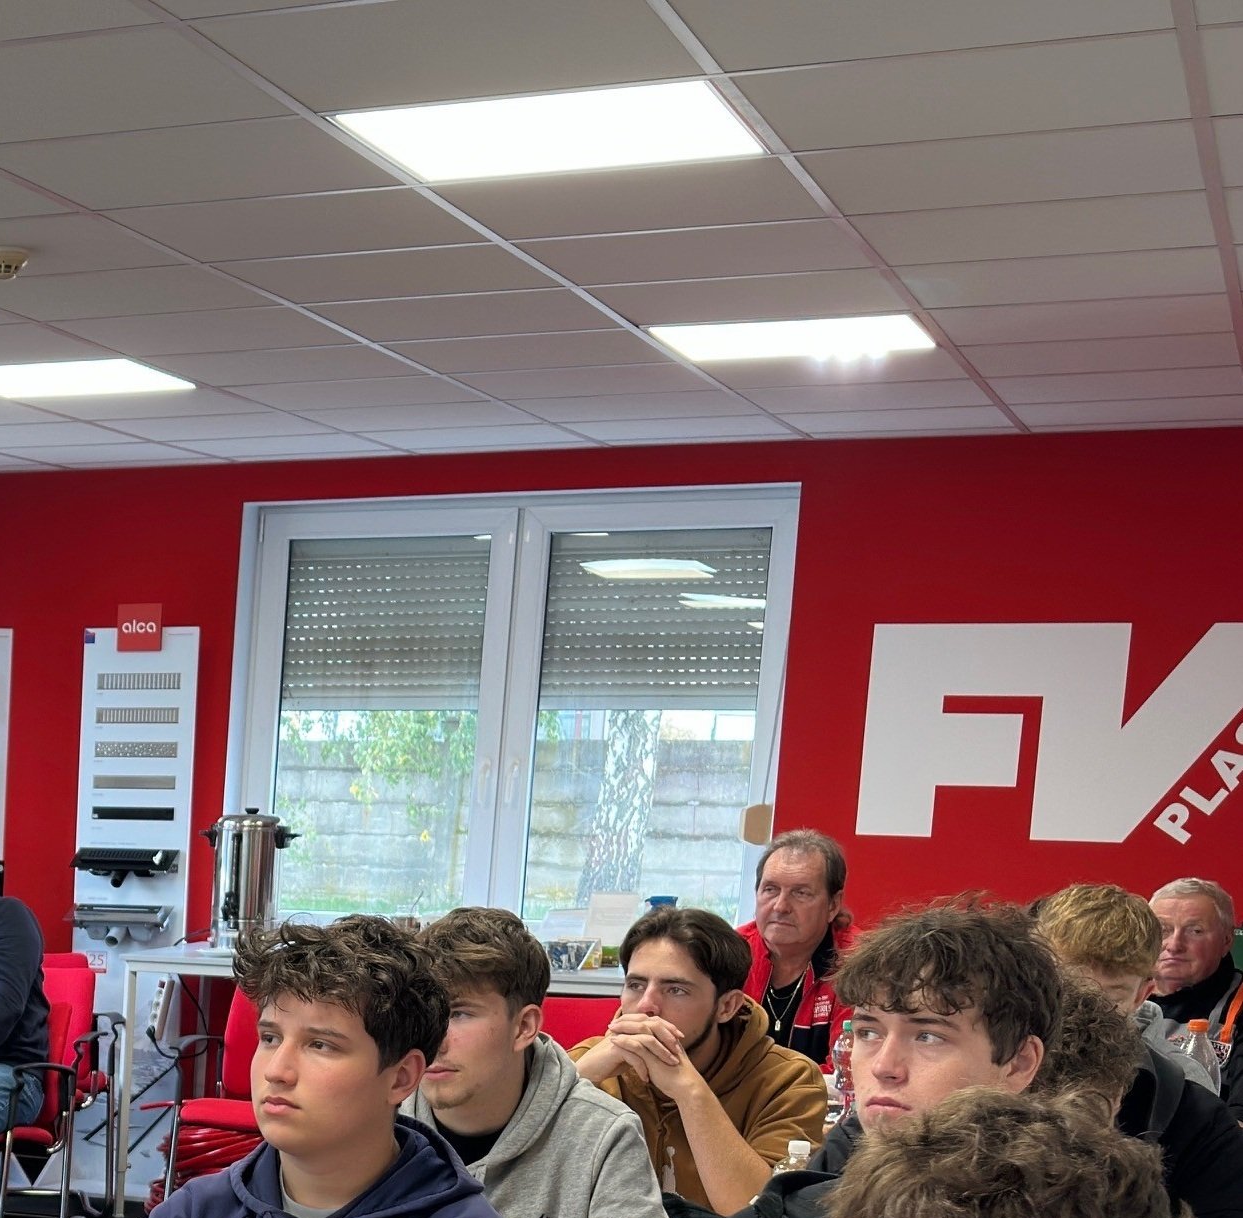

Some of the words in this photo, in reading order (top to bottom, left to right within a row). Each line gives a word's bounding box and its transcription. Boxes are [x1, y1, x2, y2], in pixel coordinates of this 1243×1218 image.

[121, 619, 157, 633] alca
[1152, 722, 1243, 845] PLA
[89, 953, 104, 966] 25
